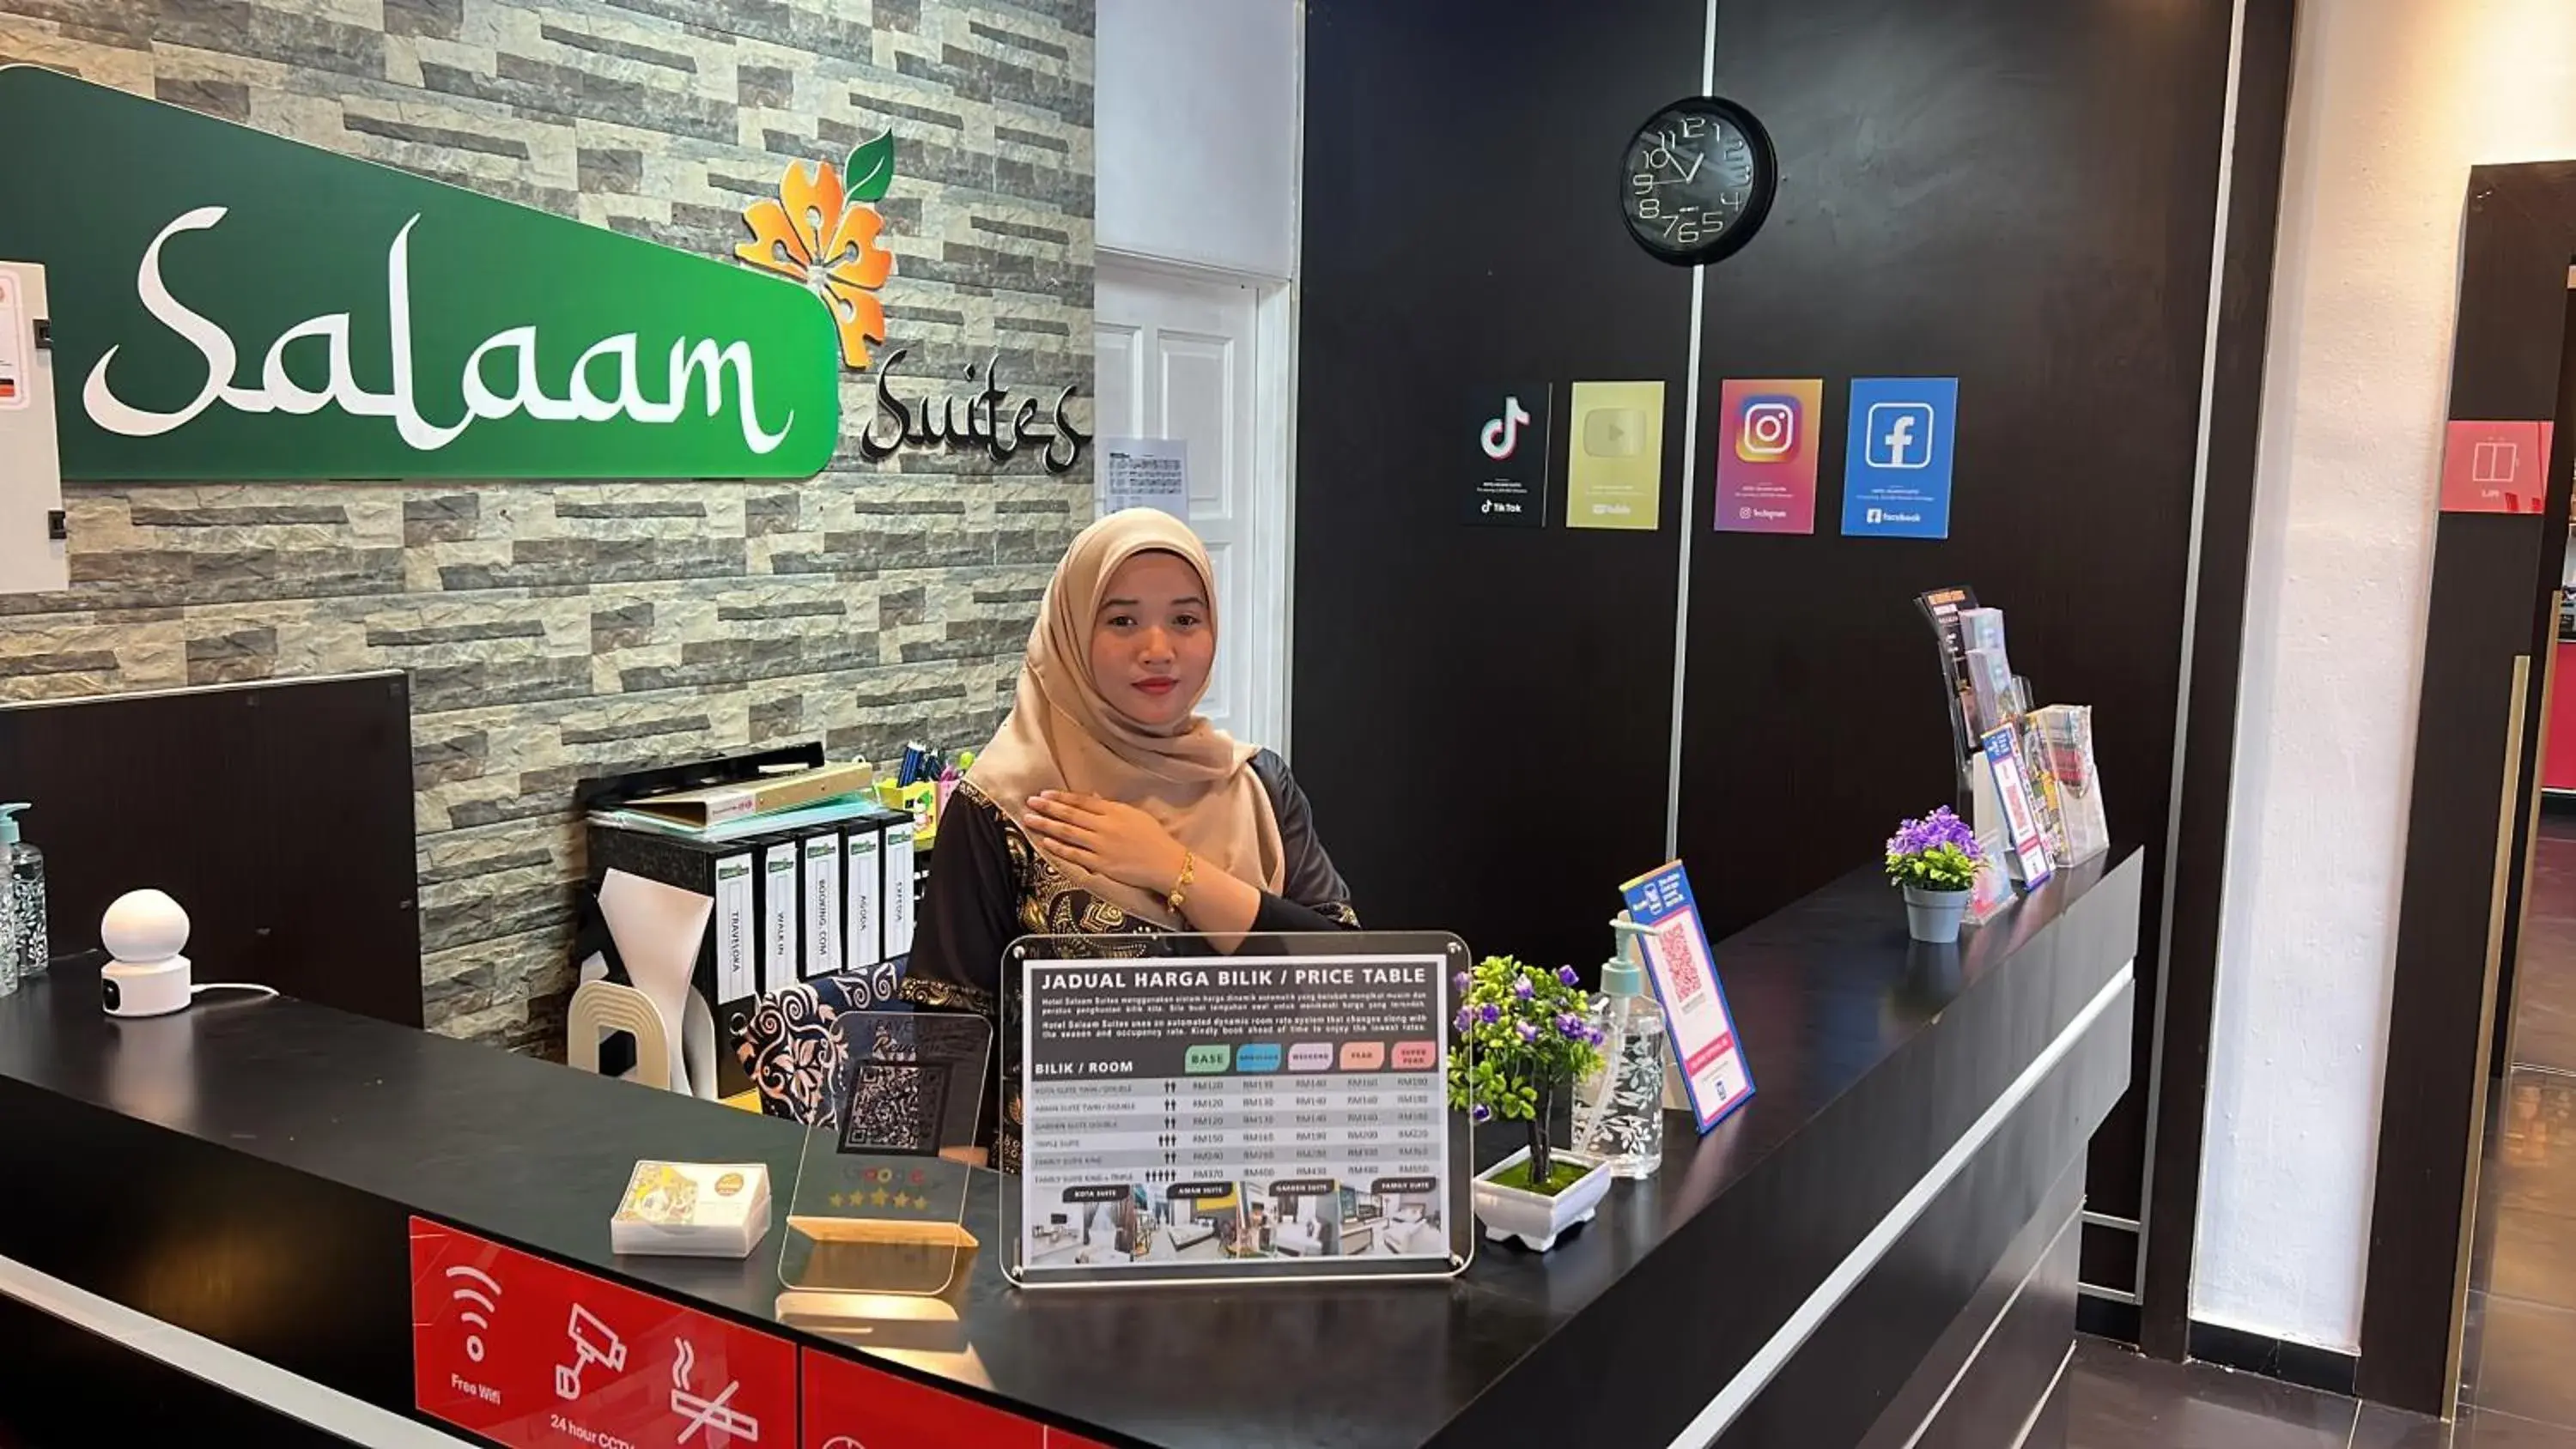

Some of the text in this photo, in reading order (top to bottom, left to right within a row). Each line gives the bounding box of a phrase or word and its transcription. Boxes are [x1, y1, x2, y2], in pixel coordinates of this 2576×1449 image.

[1680, 117, 1706, 138] 12
[1713, 123, 1721, 142] 1
[1658, 130, 1675, 149] 11
[1724, 138, 1744, 161] 2
[1643, 148, 1670, 169] 10
[1633, 174, 1654, 195] 9
[1728, 166, 1751, 188] 3
[1639, 198, 1659, 219] 8
[1720, 191, 1741, 211] 4
[1662, 215, 1680, 238] 7
[1678, 221, 1699, 243] 6
[1702, 211, 1723, 233] 5
[83, 206, 794, 454] Salaam
[860, 349, 1094, 475] Suites
[776, 912, 785, 942] WALK
[731, 912, 740, 973] TRAVELOKA
[1041, 967, 1426, 989] JADUAL HARGA BILIK / PRICE TABLE
[1035, 1061, 1133, 1075] BILIK / ROOM
[1191, 1053, 1224, 1064] BASE
[451, 1373, 501, 1406] Free Wifi
[550, 1414, 567, 1431] 24
[568, 1420, 597, 1444] hour
